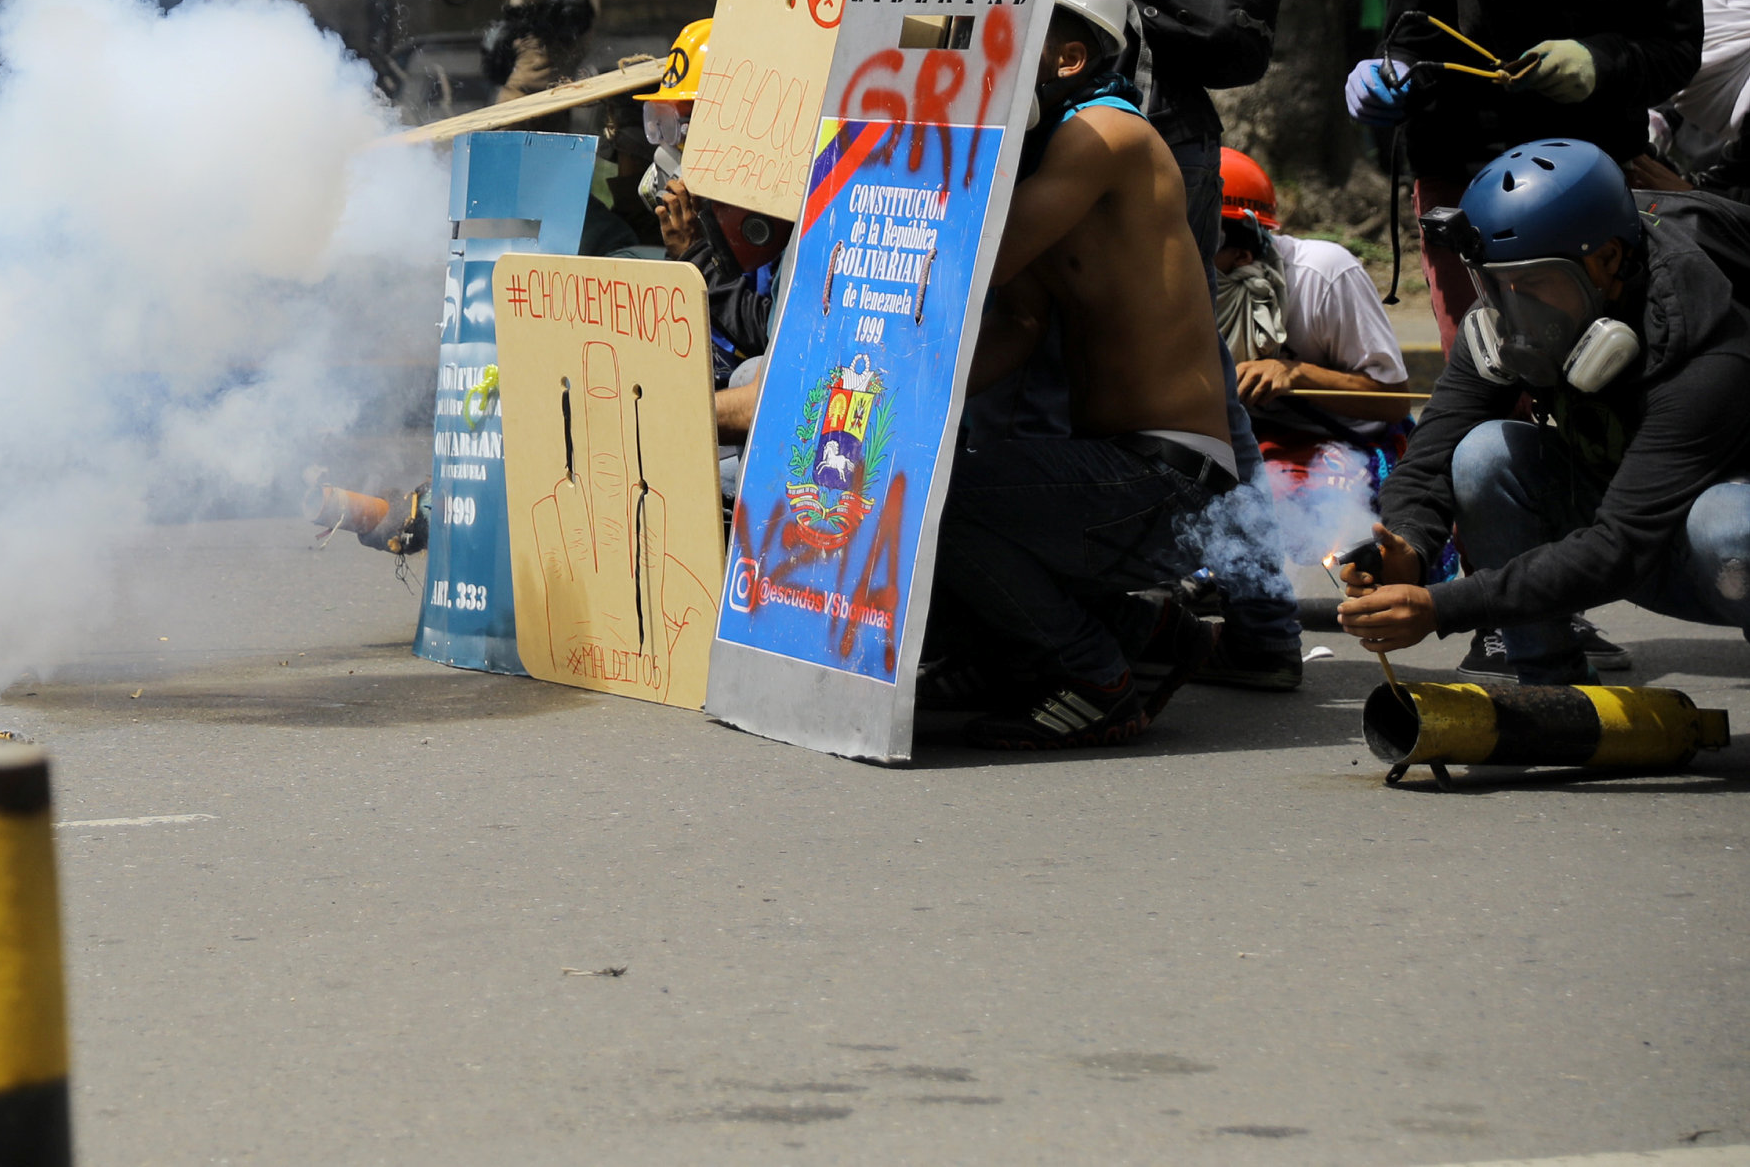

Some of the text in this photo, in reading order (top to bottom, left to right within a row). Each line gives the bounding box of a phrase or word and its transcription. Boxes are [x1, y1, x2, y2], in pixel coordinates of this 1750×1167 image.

[693, 57, 827, 160] #CHOQU
[849, 183, 951, 221] CONSTITUCIÓN
[850, 214, 938, 258] de la República
[505, 269, 692, 358] #CHOQUEMENORS
[842, 281, 912, 315] de Venezuela
[854, 315, 886, 344] 1999
[455, 581, 488, 611] 333
[757, 576, 894, 630] @escudosVSbombas
